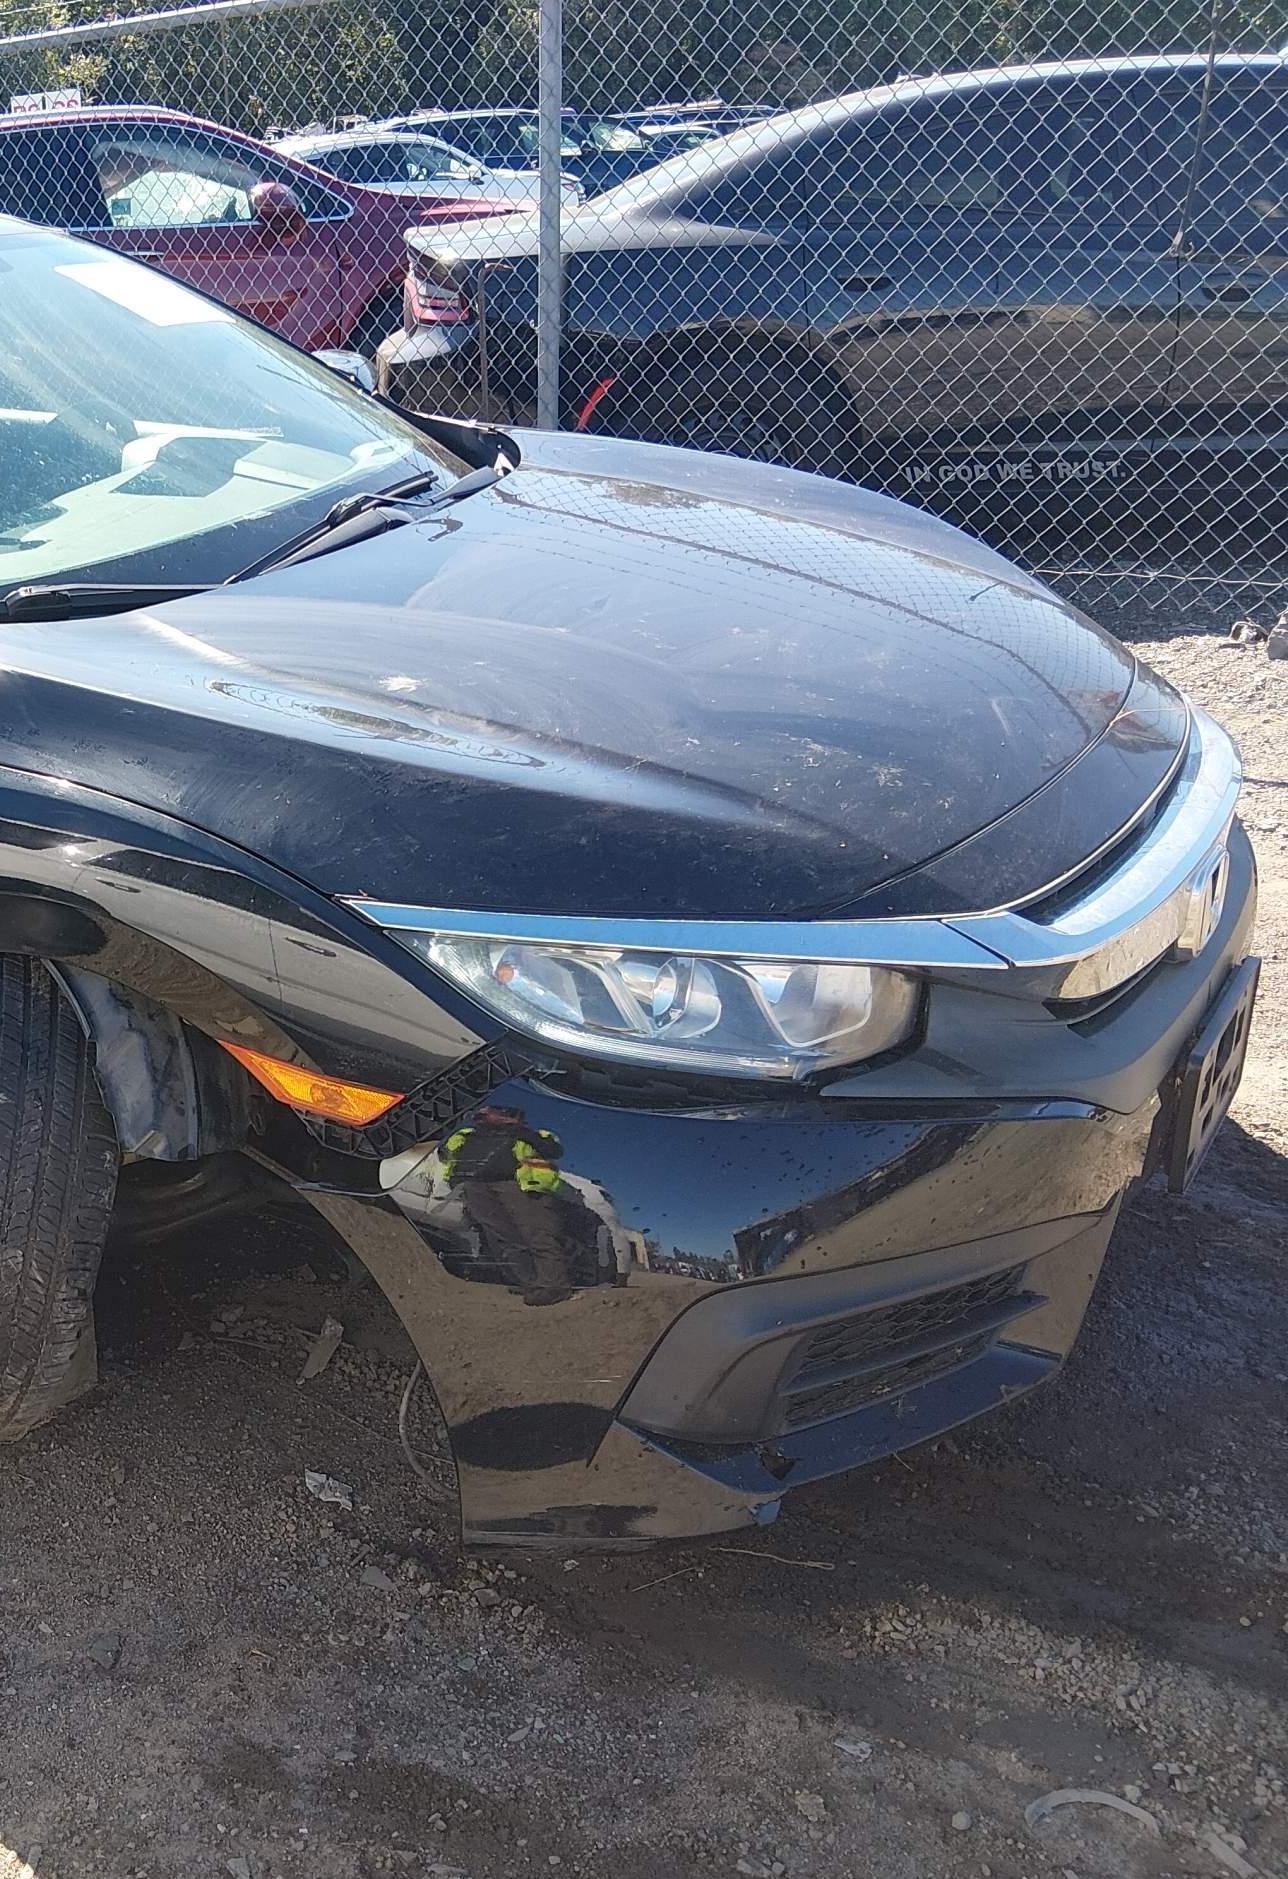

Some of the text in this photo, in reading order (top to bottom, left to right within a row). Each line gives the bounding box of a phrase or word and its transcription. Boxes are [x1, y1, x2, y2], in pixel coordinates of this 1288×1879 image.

[904, 466, 931, 483] IN
[938, 463, 990, 482] GOD
[996, 462, 1034, 480] WE
